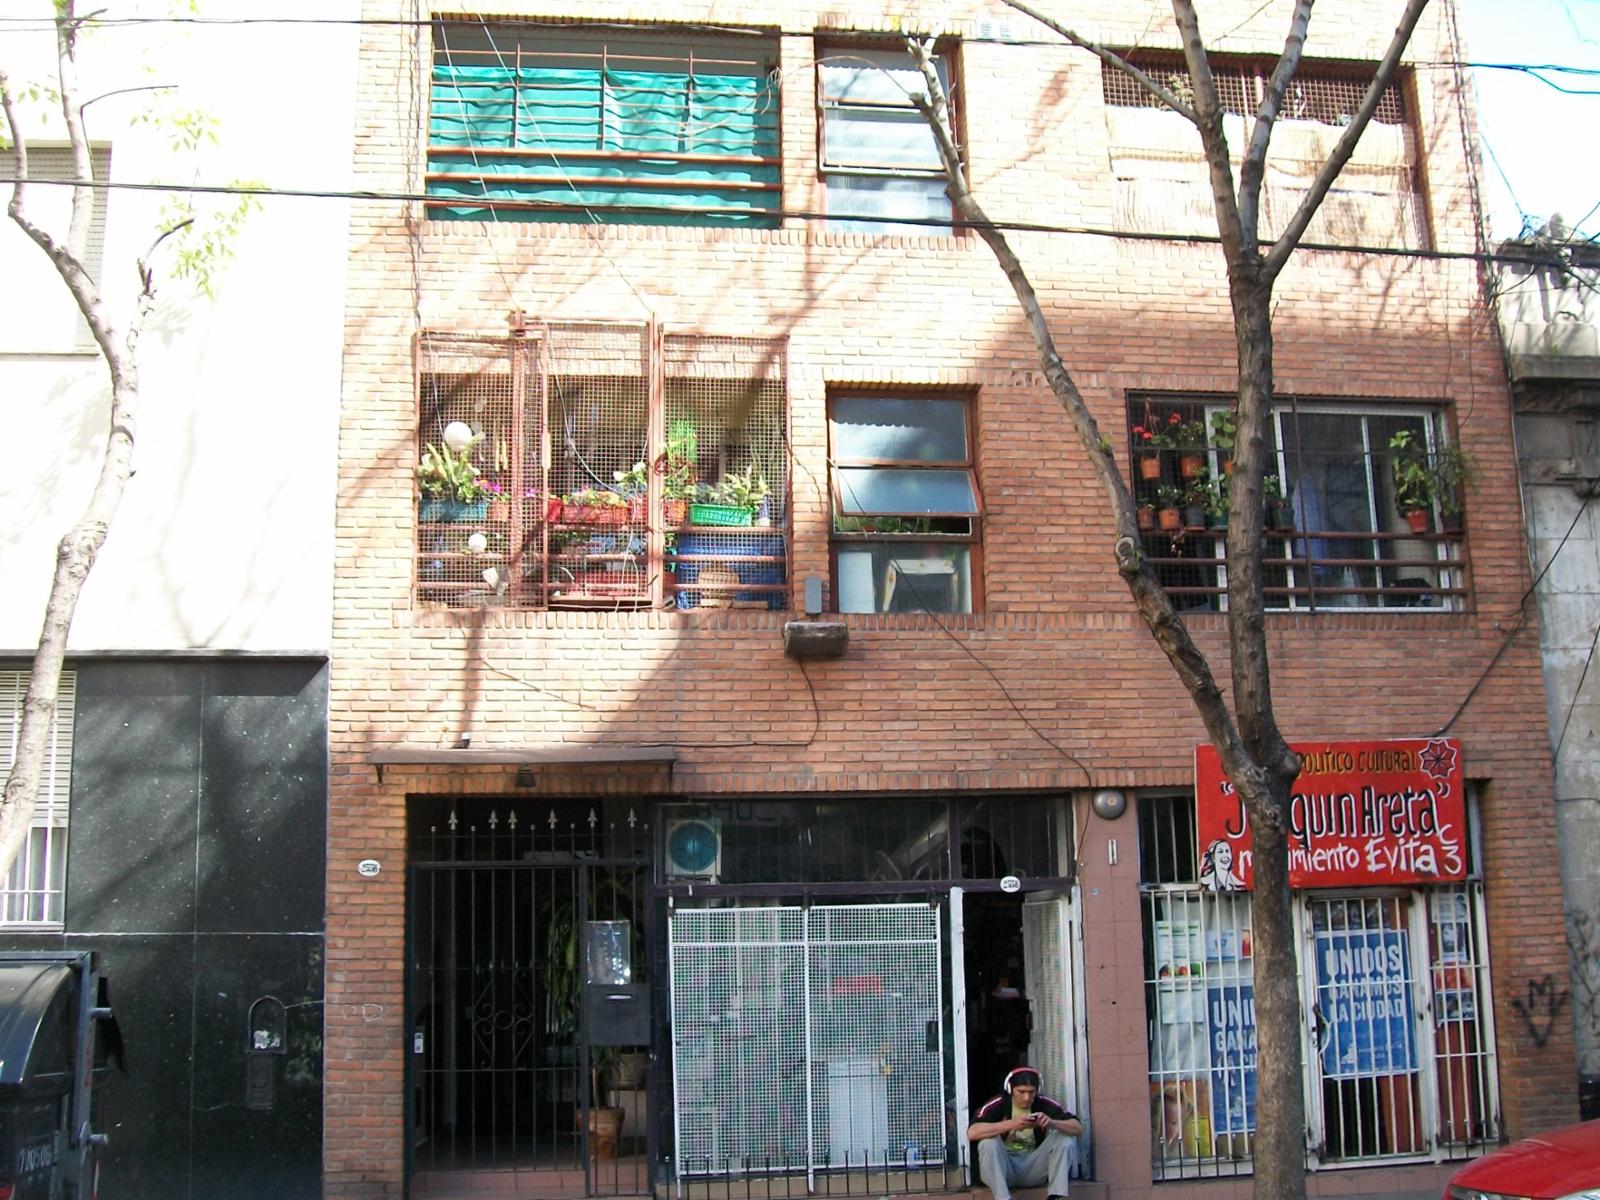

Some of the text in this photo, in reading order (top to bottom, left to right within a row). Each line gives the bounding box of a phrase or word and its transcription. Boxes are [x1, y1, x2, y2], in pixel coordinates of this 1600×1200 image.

[1364, 836, 1440, 877] Evita
[1325, 944, 1400, 976] UNIDOS
[1328, 974, 1402, 999] GANAMOS
[1353, 998, 1404, 1021] CIUDAD
